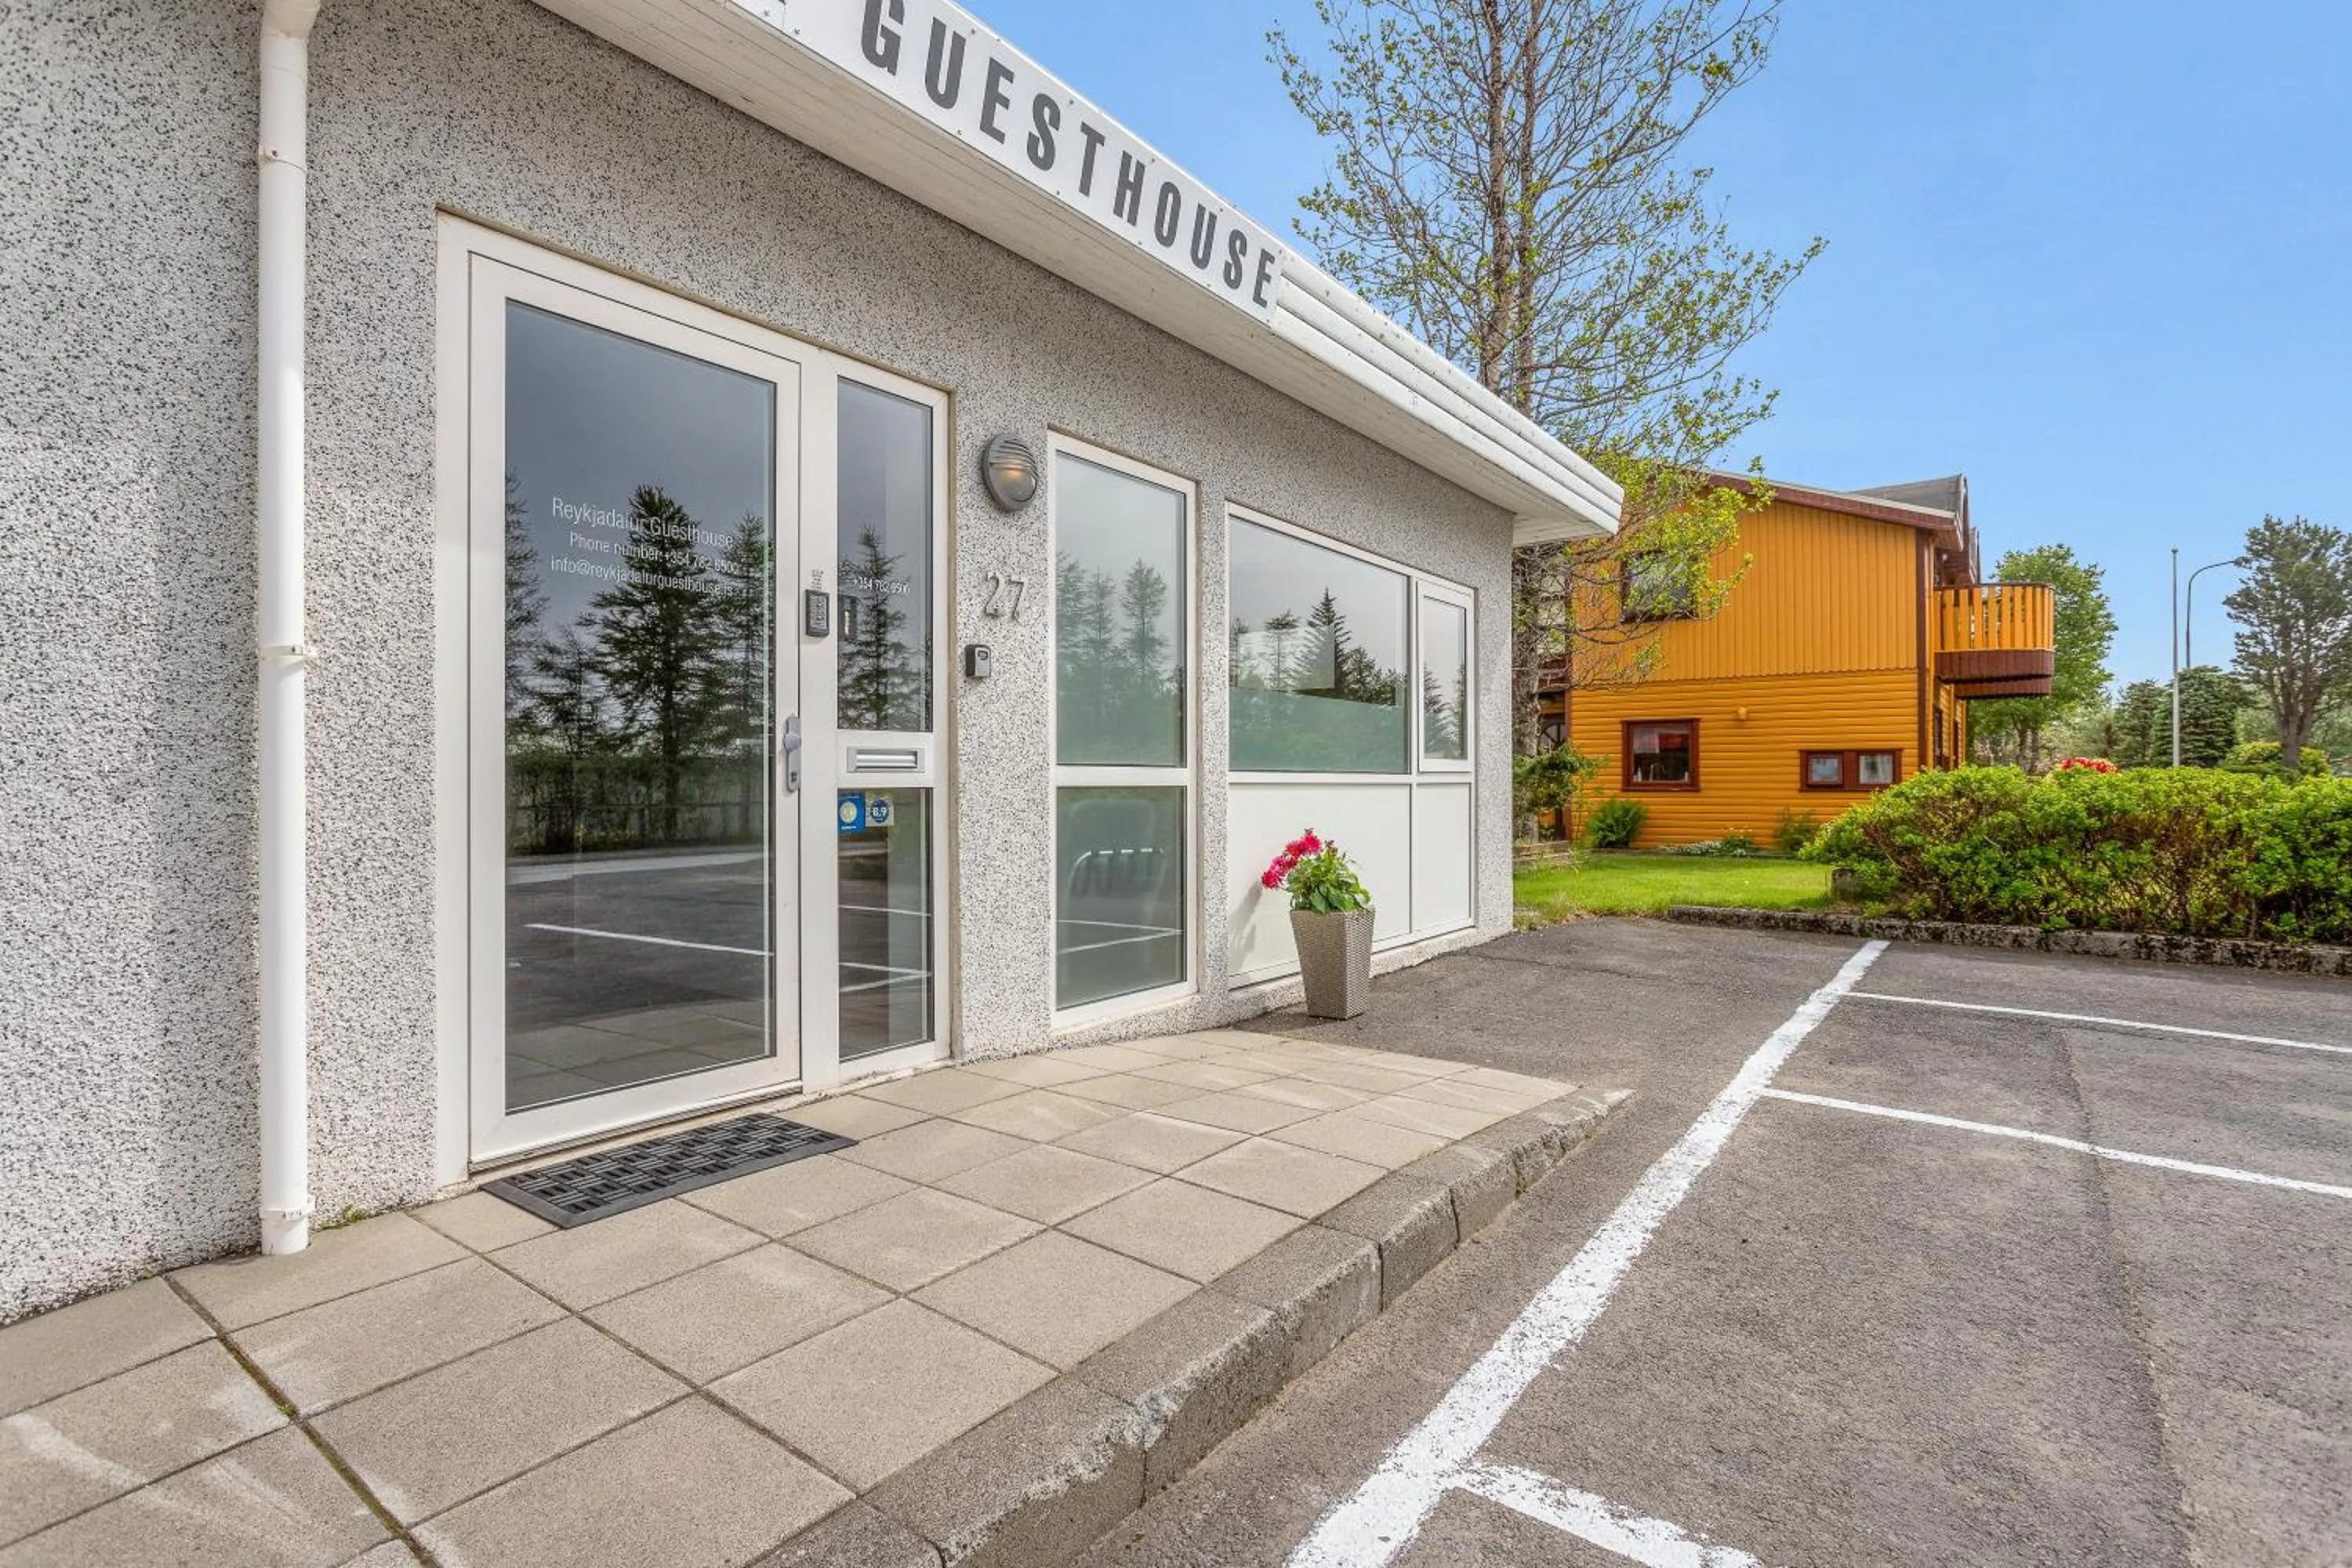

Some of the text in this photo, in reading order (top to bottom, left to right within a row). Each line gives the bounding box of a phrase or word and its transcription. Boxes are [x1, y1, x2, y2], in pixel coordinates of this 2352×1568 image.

[861, 0, 1276, 309] GUESTHOUSE
[552, 497, 733, 549] Reykjadalur Guesthouse
[569, 531, 610, 553] Phone
[614, 541, 662, 562] number:
[665, 550, 690, 566] +354
[984, 572, 1029, 620] 27
